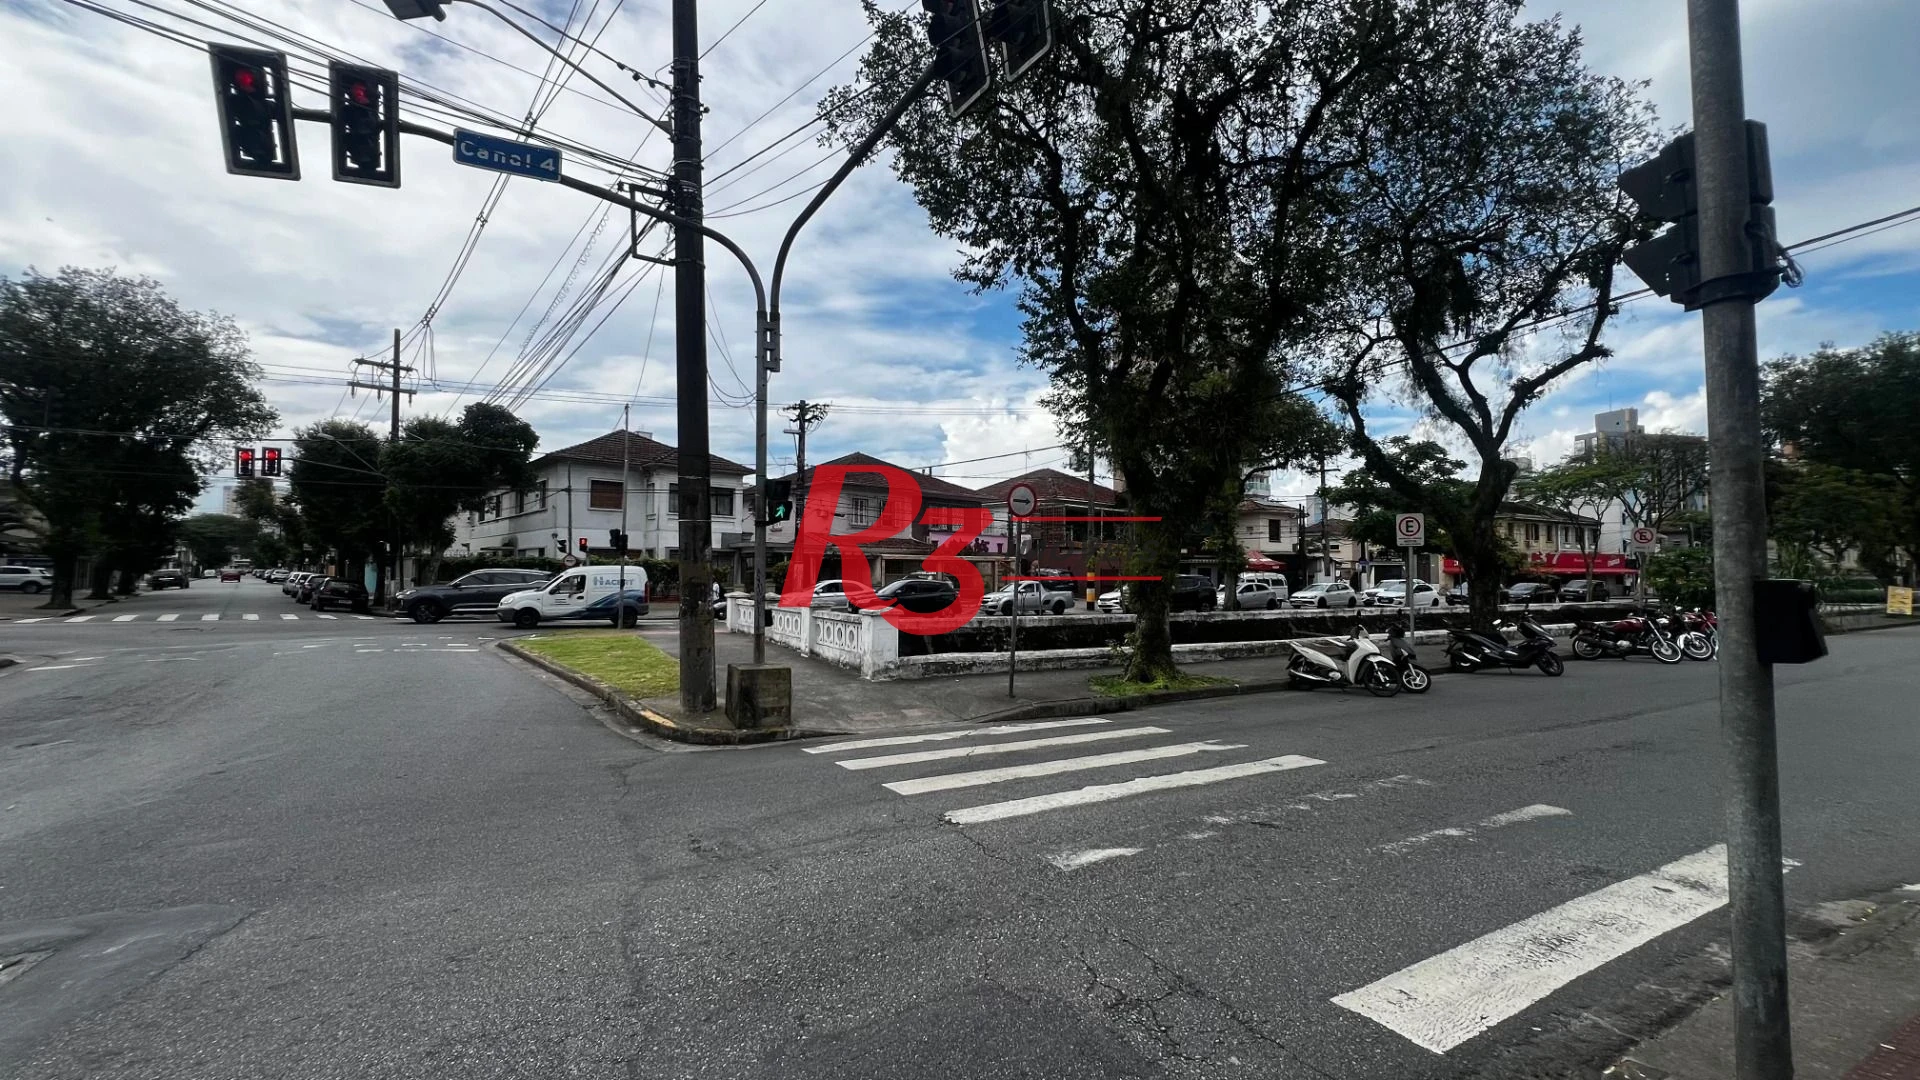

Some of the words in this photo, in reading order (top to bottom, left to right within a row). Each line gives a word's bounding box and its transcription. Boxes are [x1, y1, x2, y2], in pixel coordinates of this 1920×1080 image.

[460, 140, 531, 168] Canal
[540, 158, 555, 171] 4
[1406, 520, 1414, 533] E
